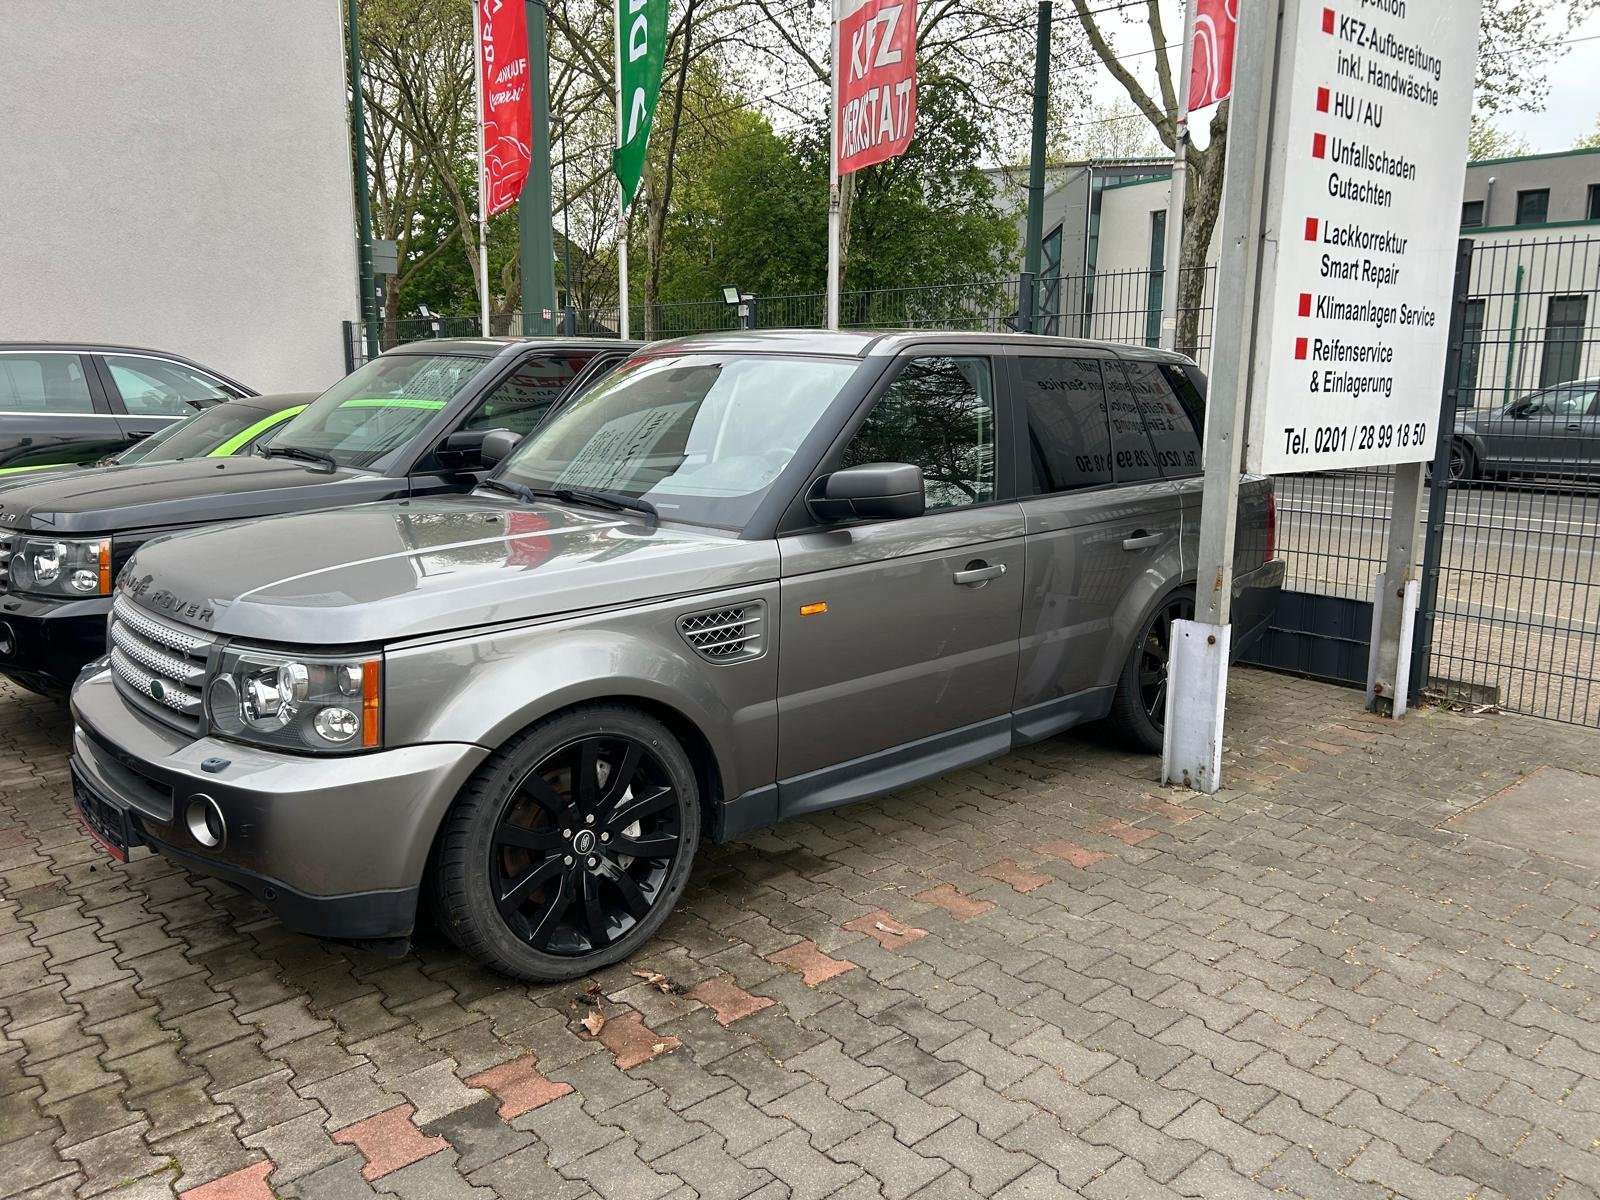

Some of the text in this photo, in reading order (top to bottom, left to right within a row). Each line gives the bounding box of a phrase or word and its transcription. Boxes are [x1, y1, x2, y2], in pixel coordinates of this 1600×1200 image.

[849, 4, 904, 84] KFZ
[1340, 14, 1442, 81] KFZ-Aufbereitung
[1337, 49, 1439, 107] inkl. Handwäsche
[1334, 91, 1383, 128] HU / AU
[1331, 136, 1416, 181] Unfallschaden
[1328, 172, 1392, 208] Gutachten
[1323, 220, 1408, 255] Lackkorrektur
[1320, 253, 1400, 289] Smart Repair
[1316, 294, 1436, 329] Klimaanlagen Service
[1312, 338, 1393, 363] Reifenservice
[1309, 370, 1393, 398] & Einlagerung
[1284, 422, 1426, 455] Tel. 0201 / 28 99 18 50
[151, 591, 216, 623] ROVER
